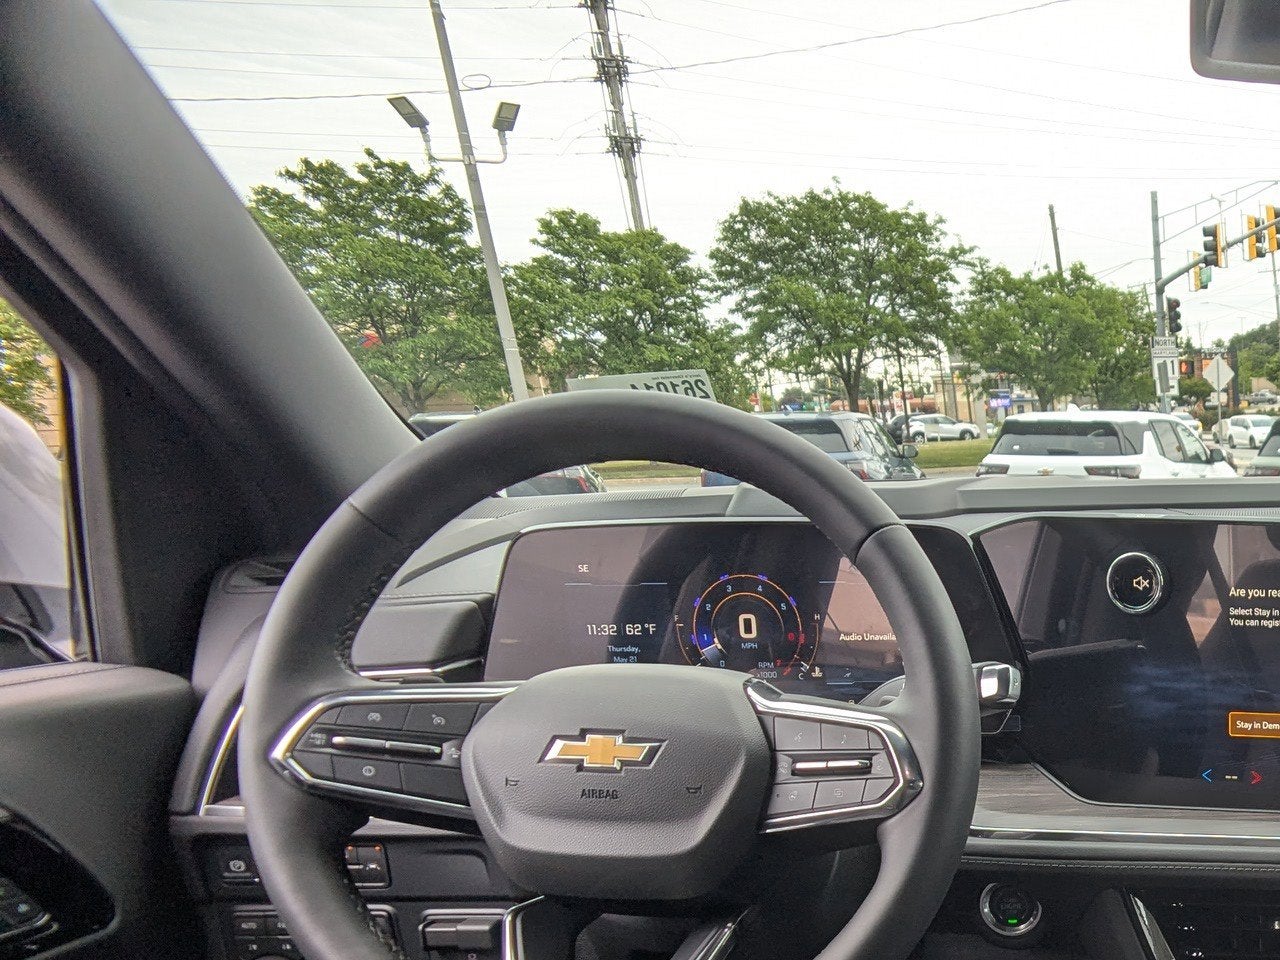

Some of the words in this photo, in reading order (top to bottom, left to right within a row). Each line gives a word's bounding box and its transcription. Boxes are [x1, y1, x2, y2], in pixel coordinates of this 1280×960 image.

[578, 565, 589, 573] SE
[1229, 587, 1246, 597] Are
[1248, 588, 1266, 600] you
[706, 603, 711, 611] 2
[781, 603, 787, 611] 5
[1229, 607, 1253, 616] Select
[1254, 608, 1271, 618] Stay
[1272, 608, 1280, 616] in
[738, 613, 758, 639] 0
[1229, 617, 1244, 626] You
[1245, 619, 1260, 627] can
[587, 624, 618, 636] 11:32
[626, 624, 642, 635] 62
[645, 623, 657, 635] °F
[703, 633, 708, 641] 1
[839, 632, 863, 641] Audio
[863, 632, 897, 641] Unavaila
[608, 645, 641, 654] Thursday,
[1236, 720, 1253, 732] Stay
[1253, 720, 1261, 730] in
[580, 788, 619, 800] AIRBAG
